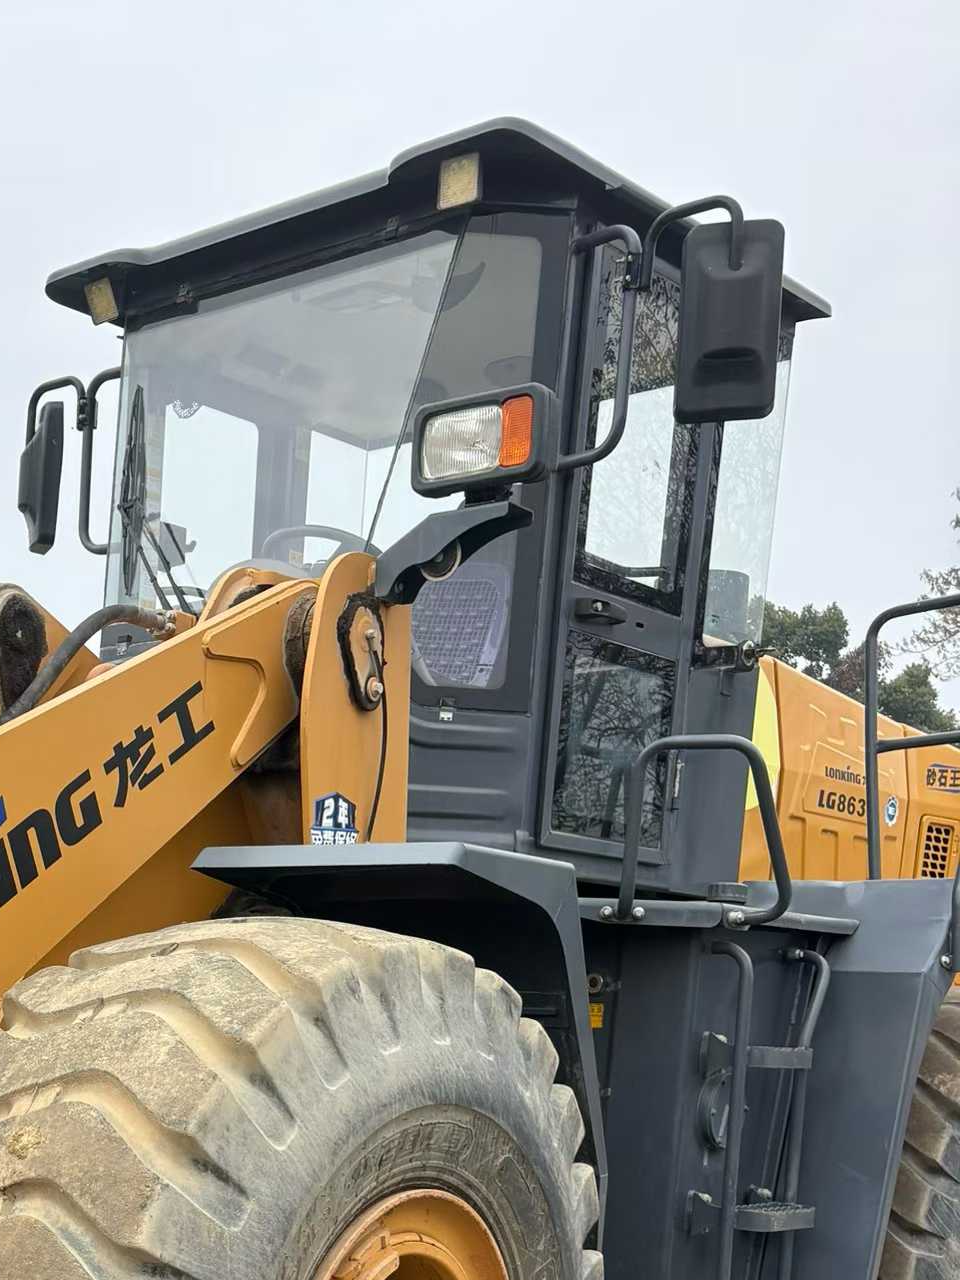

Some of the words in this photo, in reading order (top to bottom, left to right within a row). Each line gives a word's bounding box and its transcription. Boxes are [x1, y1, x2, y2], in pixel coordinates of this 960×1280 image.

[104, 680, 215, 807] 龙工
[926, 767, 960, 787] 砂石王
[818, 790, 866, 817] LG863
